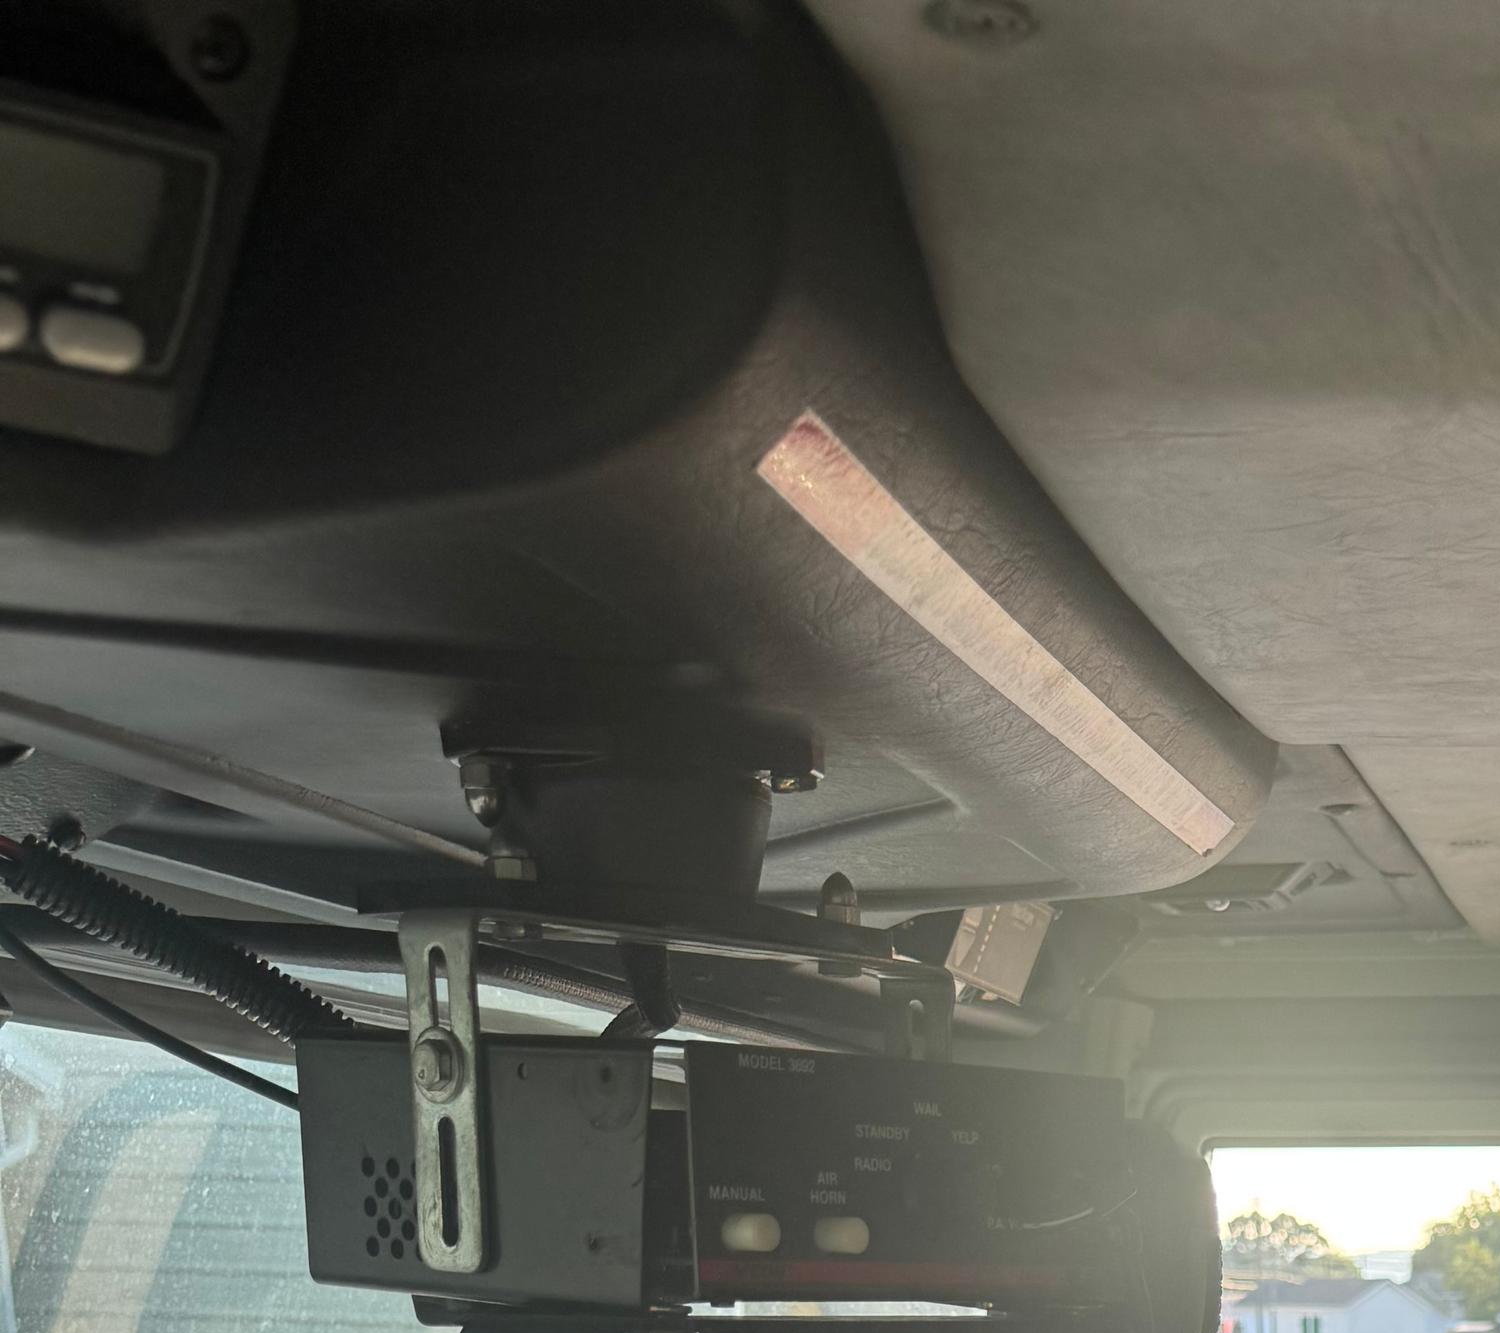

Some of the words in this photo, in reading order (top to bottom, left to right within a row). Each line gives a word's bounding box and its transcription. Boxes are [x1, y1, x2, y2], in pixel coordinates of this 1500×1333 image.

[739, 1053, 784, 1071] MODEL
[914, 1102, 941, 1117] WAIL
[855, 1124, 910, 1140] STANDBY
[952, 1130, 979, 1145] YELP
[854, 1157, 892, 1171] RADIO
[817, 1172, 838, 1186] AIR
[709, 1186, 766, 1201] MANUAL
[810, 1191, 846, 1205] HORN
